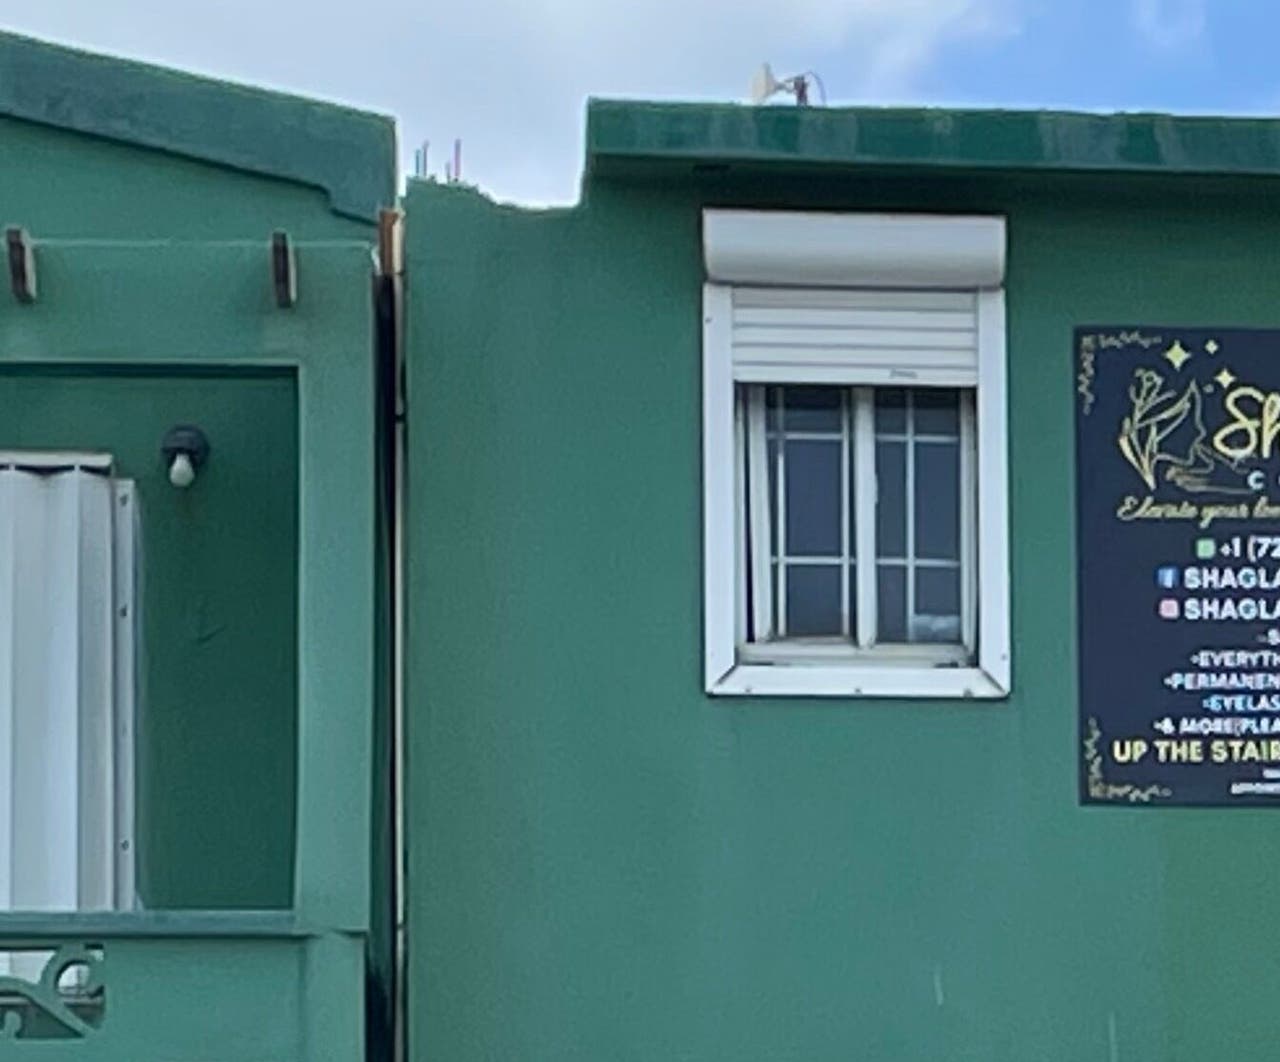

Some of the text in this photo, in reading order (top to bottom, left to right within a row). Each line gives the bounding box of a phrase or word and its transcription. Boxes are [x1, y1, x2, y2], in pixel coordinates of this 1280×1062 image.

[1199, 503, 1248, 528] your
[1219, 536, 1241, 558] +1
[1113, 740, 1147, 761] UP
[1153, 740, 1203, 761] THE
